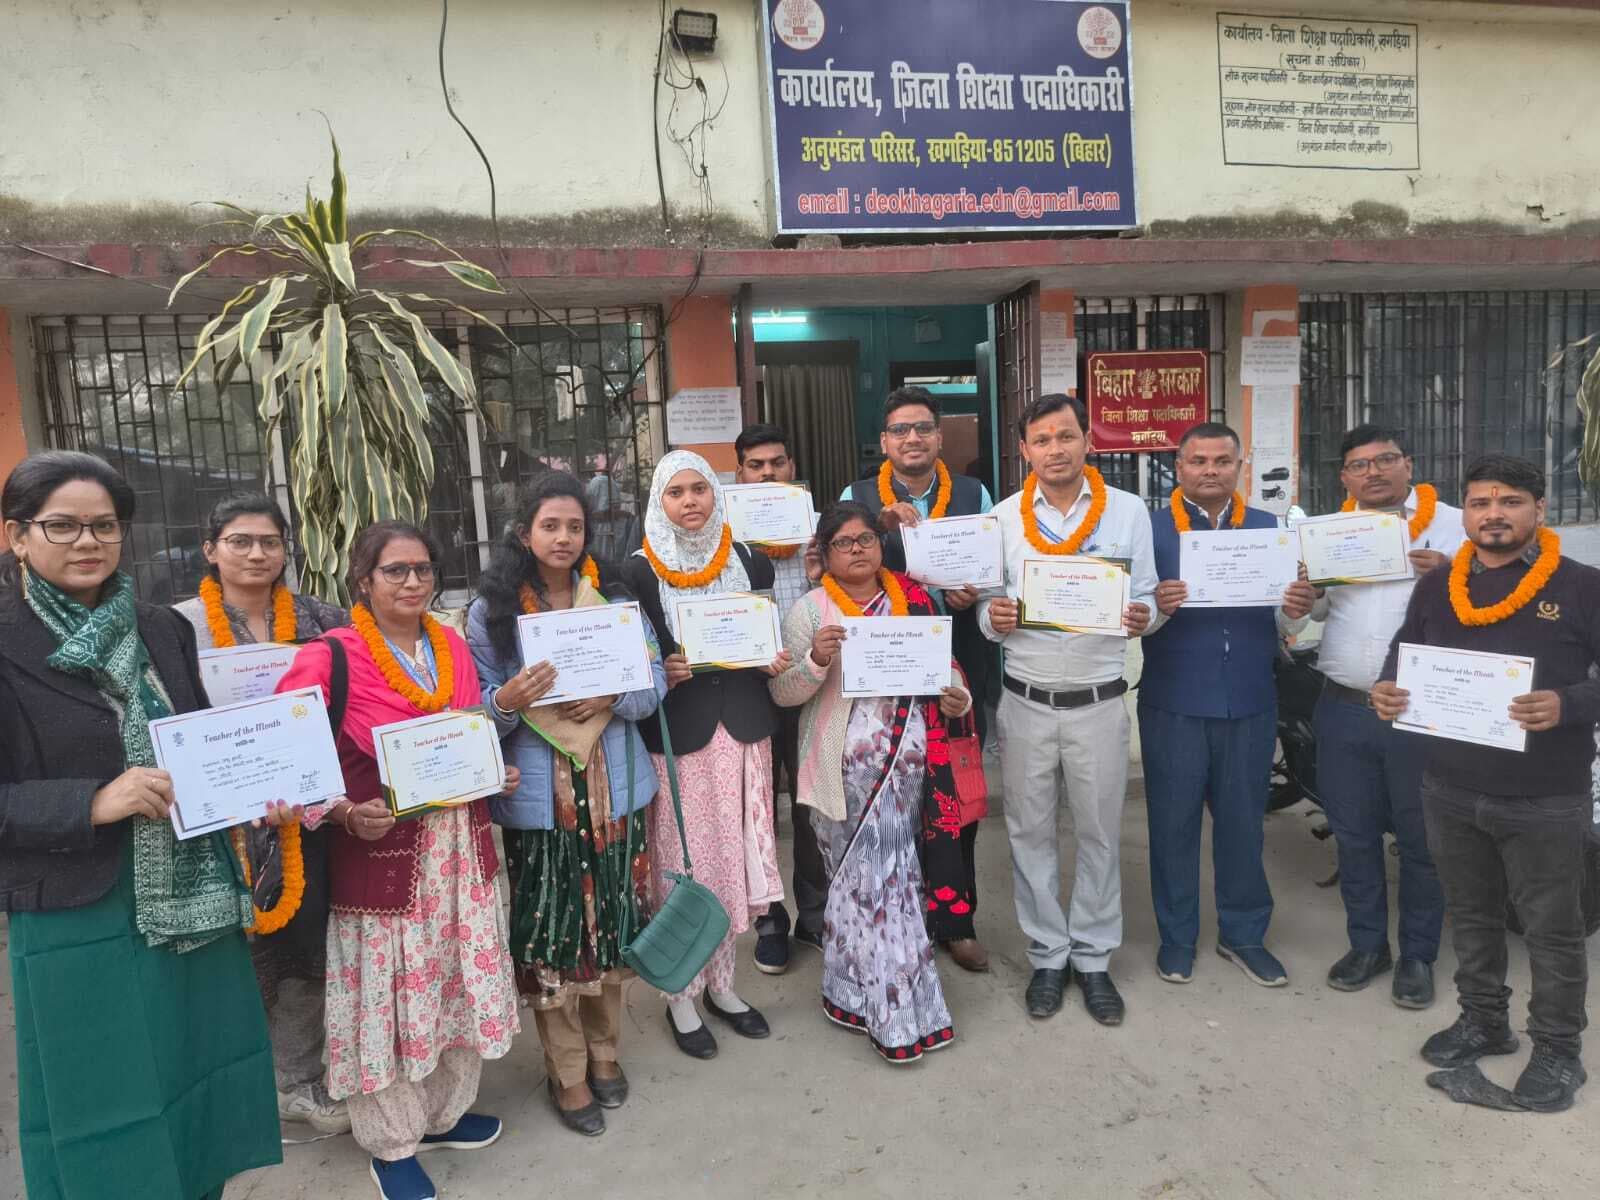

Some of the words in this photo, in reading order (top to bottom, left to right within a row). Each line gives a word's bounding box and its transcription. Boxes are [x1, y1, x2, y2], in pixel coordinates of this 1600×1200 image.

[1224, 23, 1263, 41] कार्यालय
[1300, 25, 1326, 49] शिक्षा
[777, 58, 882, 116] कार्यालय,
[956, 62, 1014, 110] शिक्षा
[1020, 66, 1125, 112] पदाधिकारी
[801, 130, 865, 170] अनुमंडल
[870, 131, 920, 167] परिसर,
[1062, 134, 1112, 168] (बिहार)
[798, 187, 850, 214] email
[854, 194, 861, 214] :
[865, 187, 1120, 219] deokhagaria.edn@gmail.com
[1094, 359, 1136, 402] बिहार
[1158, 368, 1202, 397] सरकार
[1101, 406, 1123, 424] जिला
[1126, 405, 1149, 424] शिक्षा
[1432, 665, 1455, 674] Teacher
[1456, 667, 1463, 675] of
[1473, 670, 1494, 678] Month
[204, 732, 233, 744] Teacher
[234, 728, 241, 737] of
[242, 726, 254, 735] the
[255, 720, 281, 732] Month
[413, 739, 433, 748] Teacher
[447, 730, 463, 740] Month
